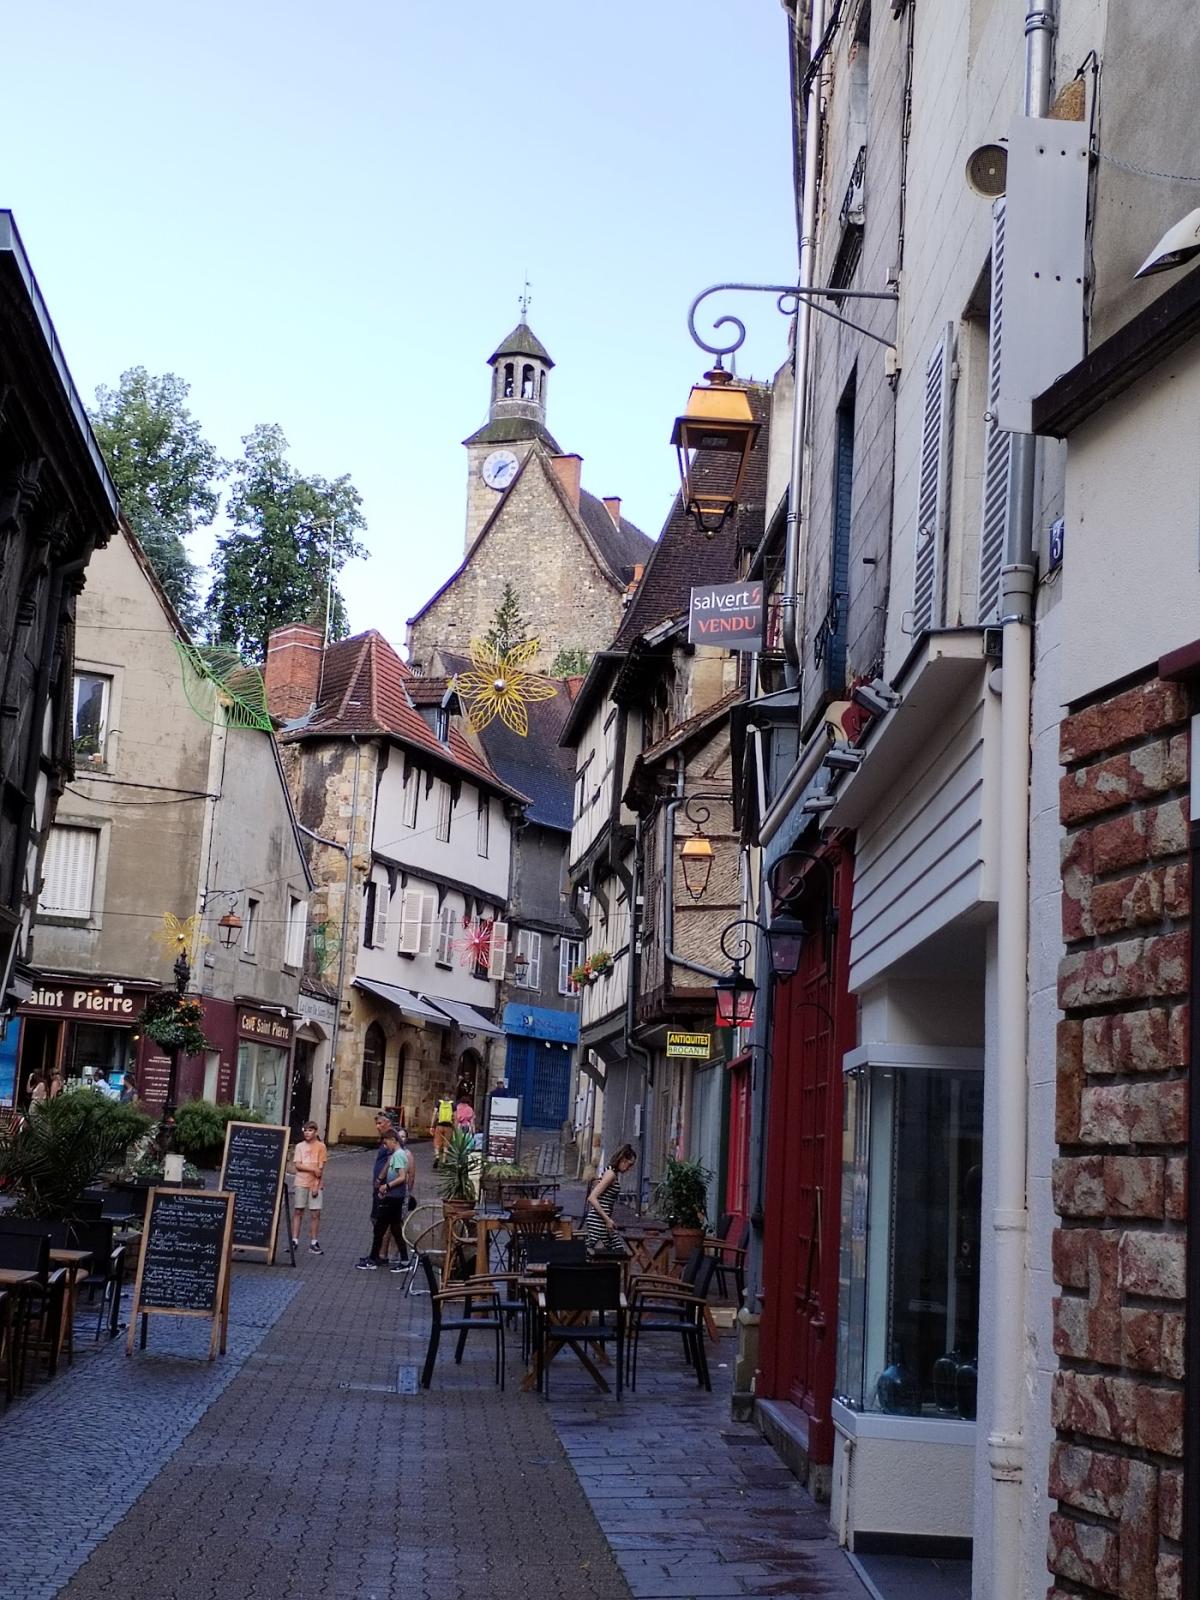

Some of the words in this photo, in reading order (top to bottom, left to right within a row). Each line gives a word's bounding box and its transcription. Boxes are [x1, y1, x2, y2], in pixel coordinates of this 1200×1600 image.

[694, 591, 750, 610] salvert
[698, 616, 756, 633] VENDU
[22, 987, 64, 1007] aint
[72, 990, 133, 1013] Pierre
[256, 1018, 271, 1036] Saint
[271, 1022, 289, 1039] Pierre
[669, 1035, 708, 1045] ANTIQUITES
[668, 1045, 709, 1055] BROCANTE
